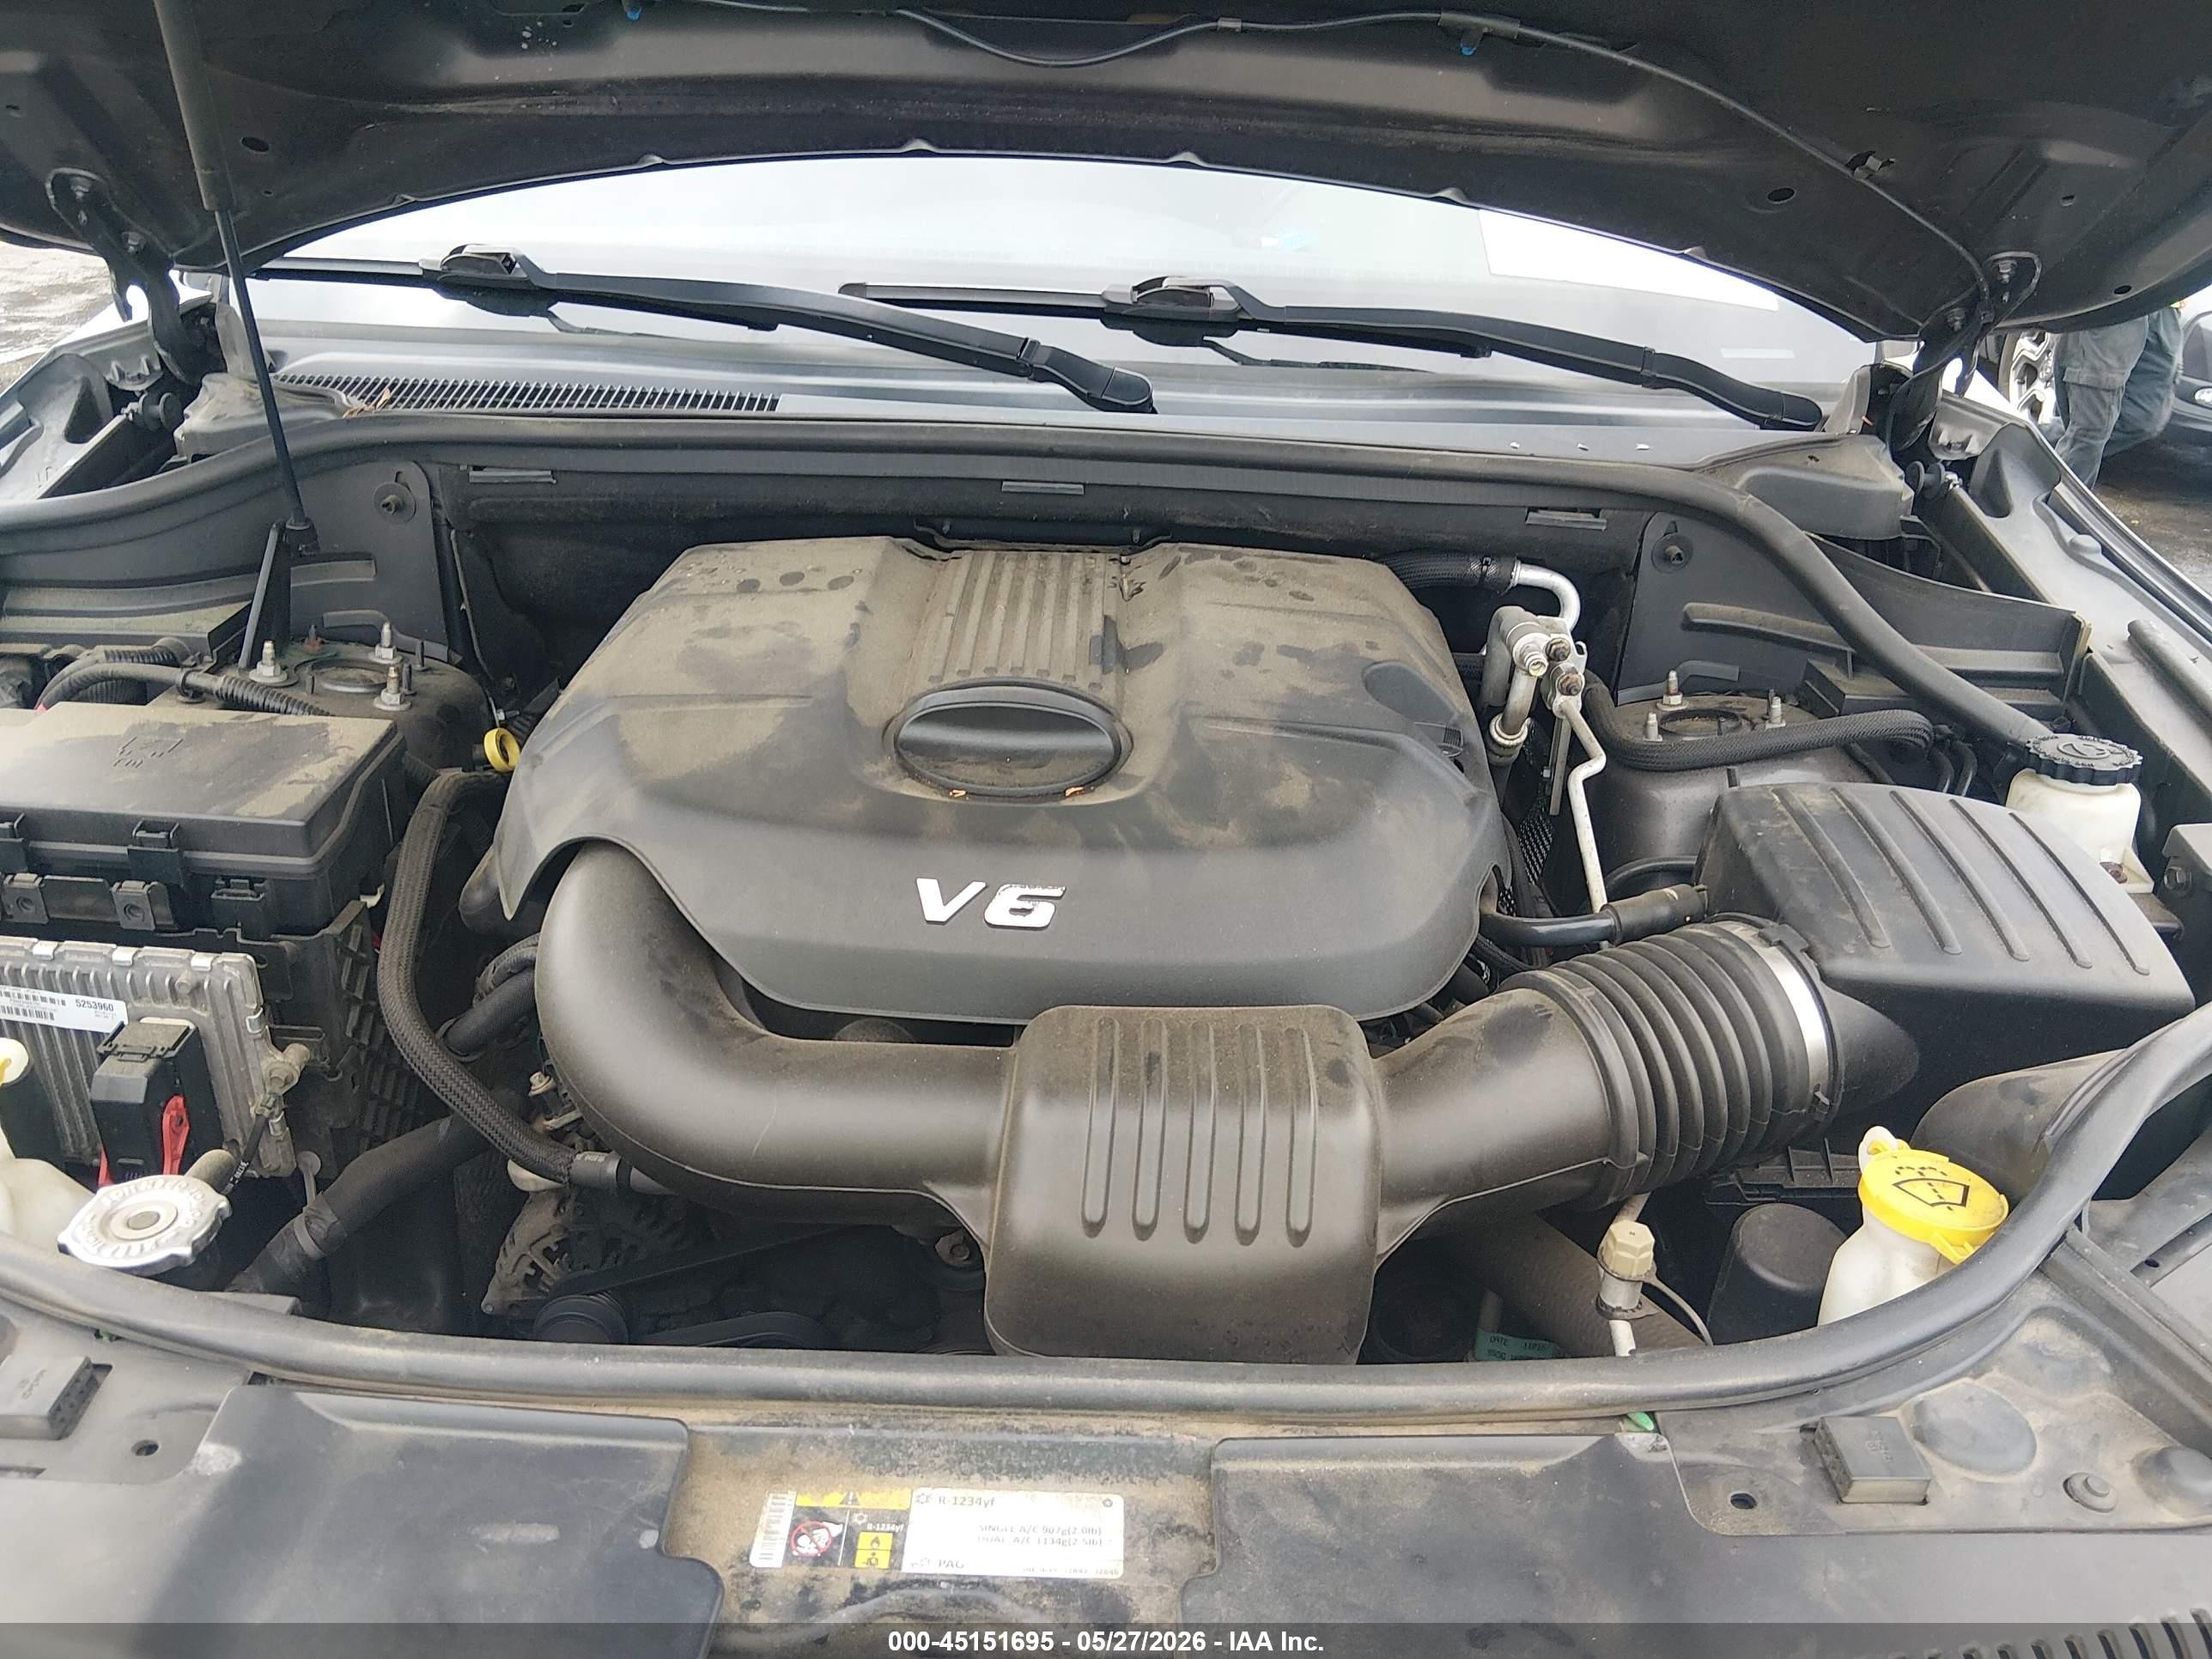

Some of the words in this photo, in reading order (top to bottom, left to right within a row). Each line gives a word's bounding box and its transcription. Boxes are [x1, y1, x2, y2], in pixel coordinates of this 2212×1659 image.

[915, 878, 1066, 931] V6
[1018, 1525, 1038, 1534] A/C
[1013, 1536, 1031, 1545] A/C
